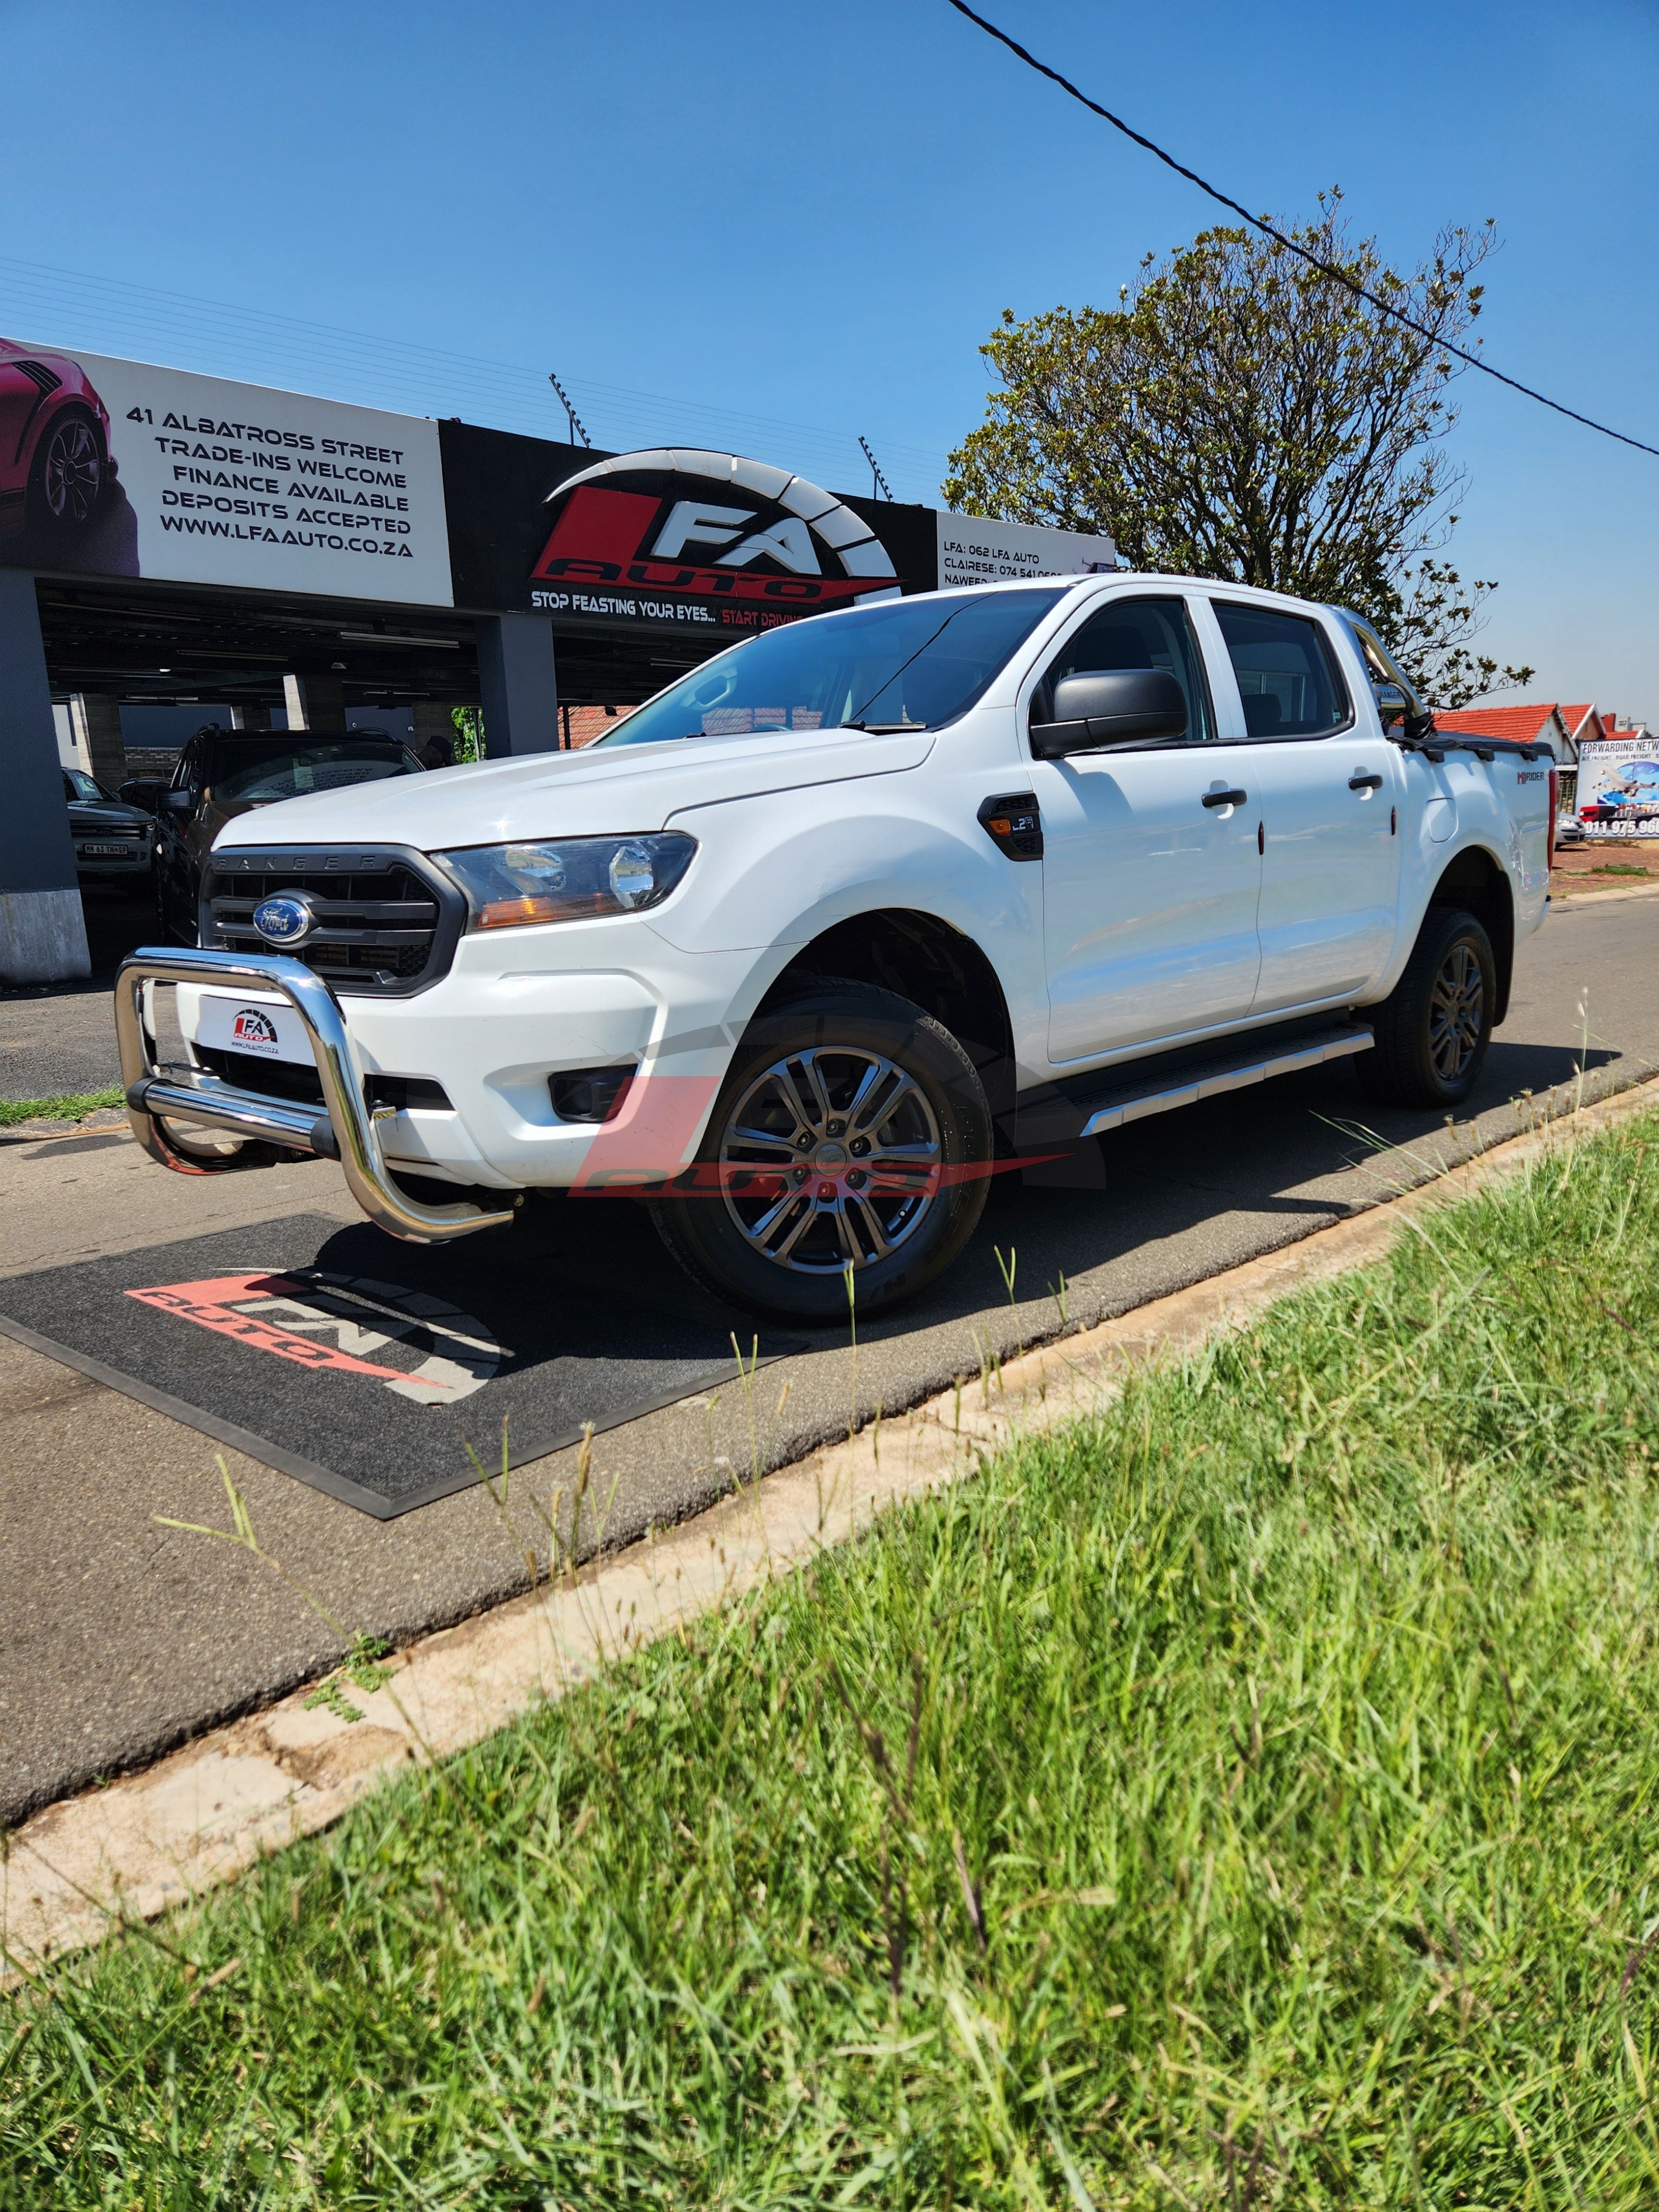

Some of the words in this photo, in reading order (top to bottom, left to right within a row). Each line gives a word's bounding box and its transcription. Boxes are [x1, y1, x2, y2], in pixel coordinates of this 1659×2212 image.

[127, 407, 154, 425] 41
[162, 412, 315, 450] ALBATROSS
[321, 439, 404, 465] STREET
[154, 437, 291, 471] TRADE-INS
[297, 458, 407, 489] WELCOME
[173, 465, 280, 494] FINANCE
[287, 482, 409, 512] AVAILABLE
[162, 490, 289, 519] DEPOSITS
[296, 508, 411, 535] ACCEPTED
[160, 515, 414, 558] WWW.LFAAUTO.CO.ZA
[944, 541, 966, 554] LFA:
[969, 545, 989, 557] 062
[993, 548, 1010, 560] LFA
[1013, 552, 1039, 564] AUTO
[545, 558, 822, 598] AUTO
[944, 558, 997, 574] CLAIRESE:
[1000, 566, 1017, 576] 074
[1020, 568, 1035, 578] 541
[531, 591, 569, 609] STOP
[572, 594, 636, 616] FEASTING
[638, 600, 674, 619] YOUR
[677, 604, 716, 623] EYES...
[722, 609, 758, 625] START
[1583, 742, 1634, 754] FORWARDING
[1585, 820, 1608, 835] 011
[1611, 820, 1636, 835] 975
[216, 855, 376, 870] RANGER
[235, 1033, 264, 1041] AUTO
